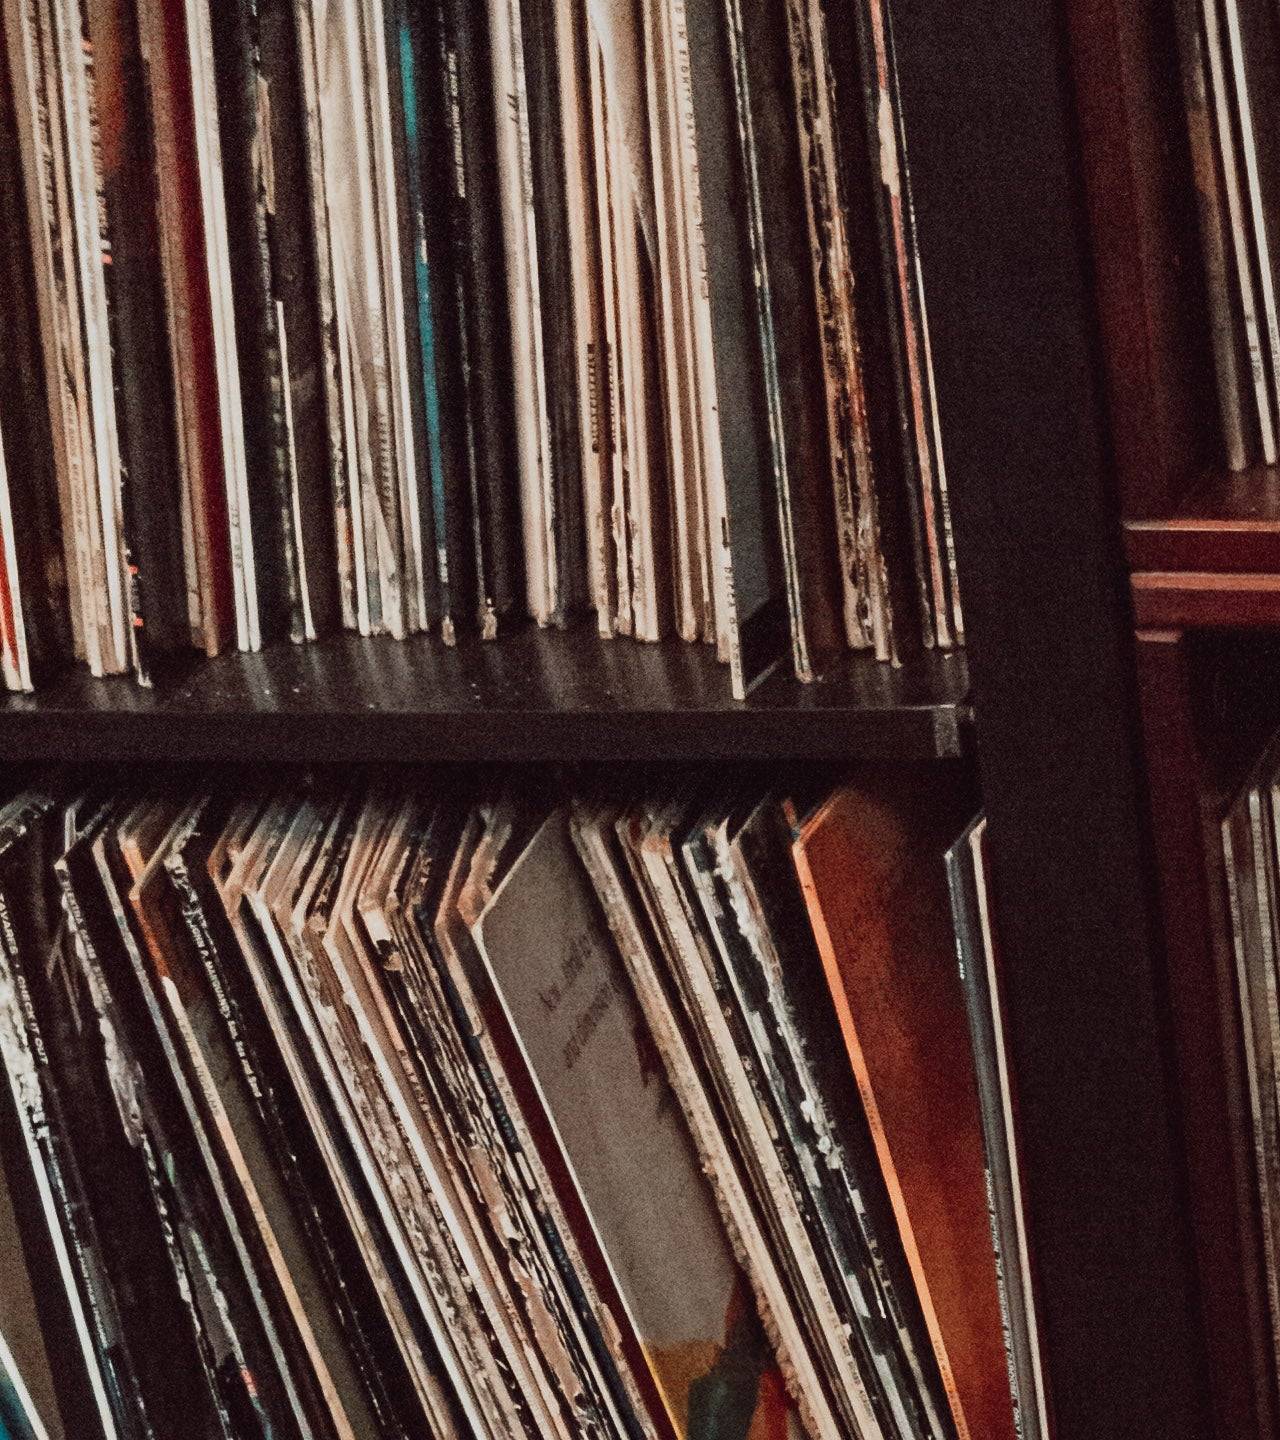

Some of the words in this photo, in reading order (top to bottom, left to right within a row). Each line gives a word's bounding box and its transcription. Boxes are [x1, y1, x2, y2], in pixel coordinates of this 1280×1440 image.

[62, 879, 84, 925] ELEKTRA
[15, 974, 36, 1021] CHECK
[28, 1021, 40, 1033] IT
[33, 1036, 49, 1066] OUT
[981, 1168, 995, 1212] SCIENCE
